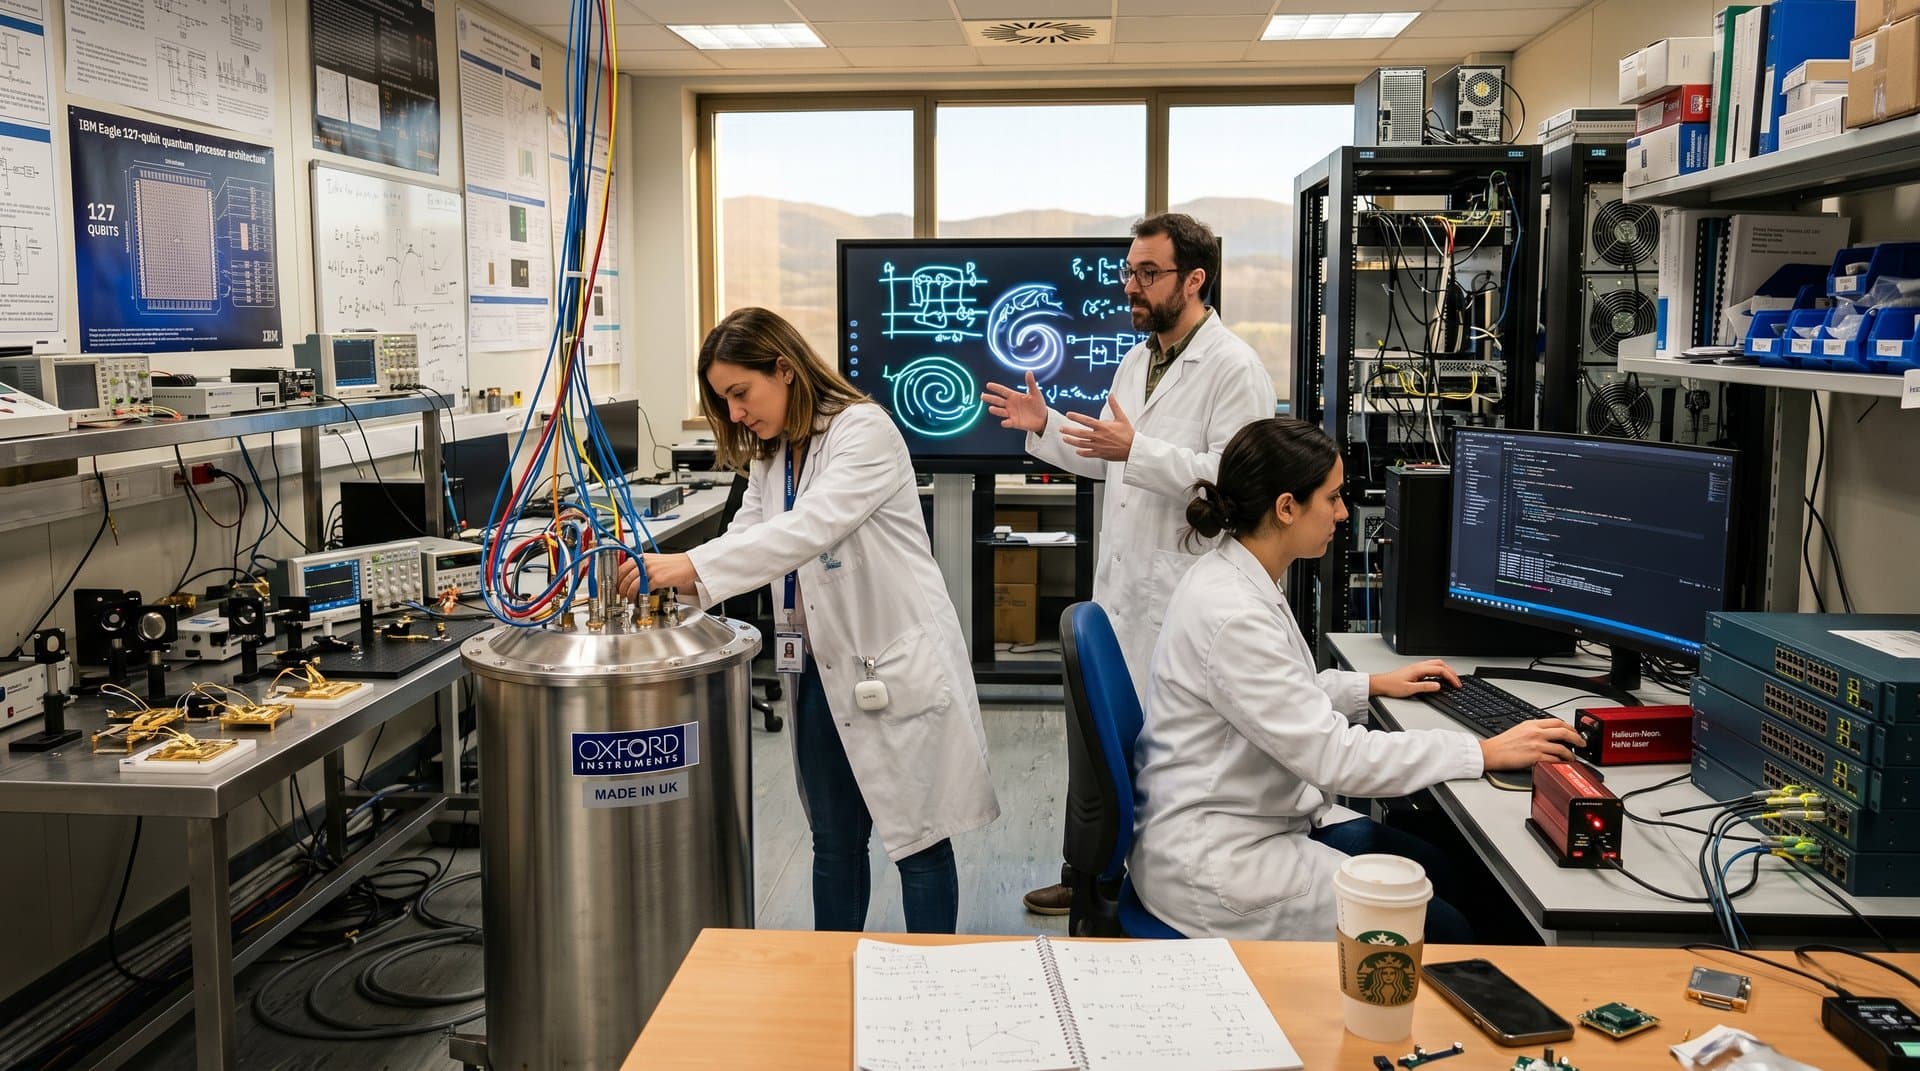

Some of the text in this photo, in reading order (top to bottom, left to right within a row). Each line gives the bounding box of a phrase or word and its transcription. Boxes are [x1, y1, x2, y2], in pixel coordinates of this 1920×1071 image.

[79, 119, 266, 165] IBM Eagle 127-qubit quantum processor architecture
[87, 202, 115, 221] 127
[87, 224, 120, 237] QUBITS
[262, 330, 279, 342] IBM
[579, 734, 678, 760] OXFORD
[580, 754, 679, 770] INSTRUMENTS
[595, 782, 678, 801] MADE IN UK
